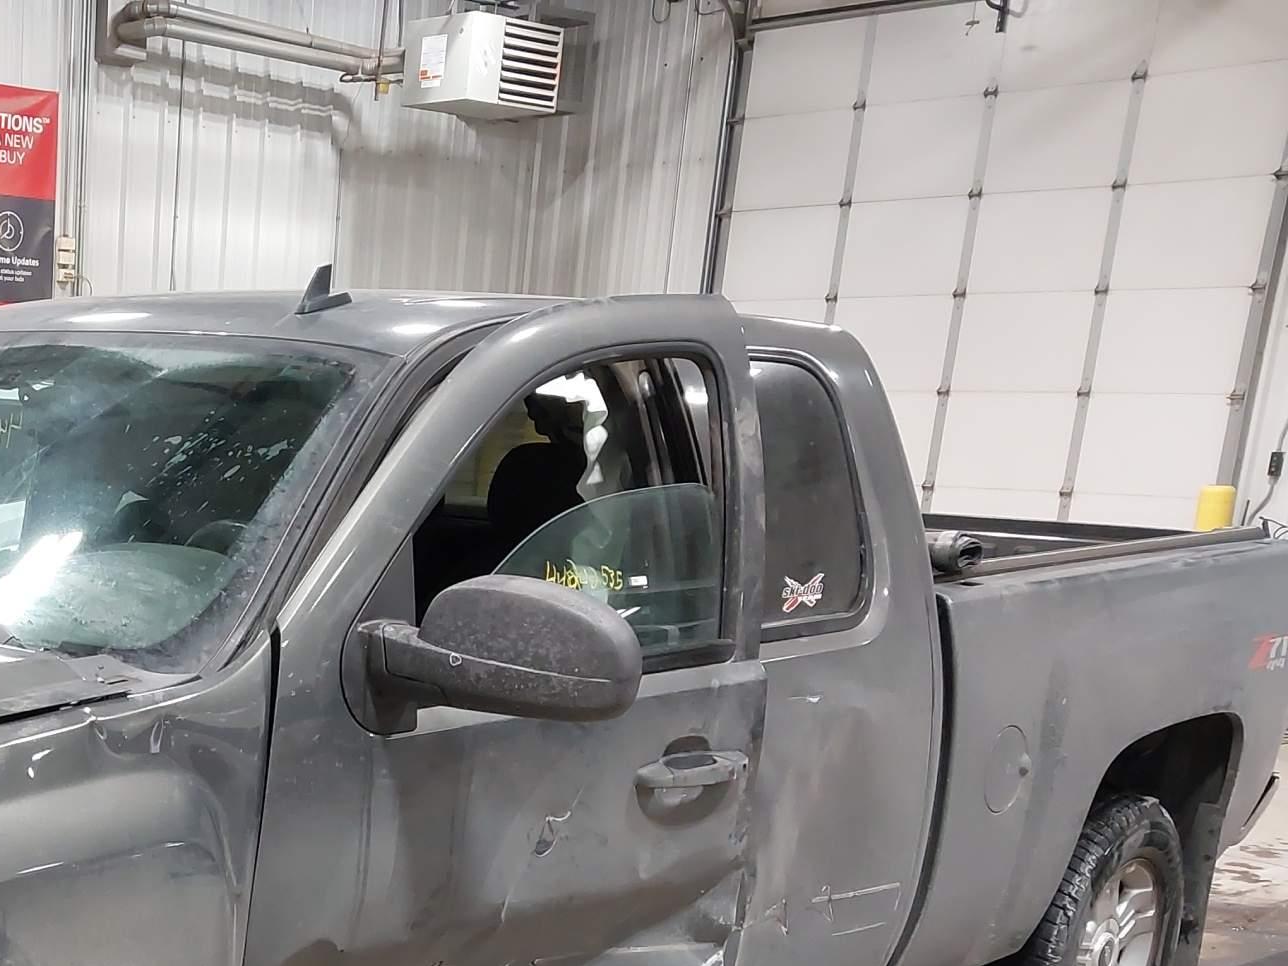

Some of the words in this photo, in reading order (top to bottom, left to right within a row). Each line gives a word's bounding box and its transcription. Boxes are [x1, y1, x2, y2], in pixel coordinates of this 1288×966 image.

[5, 133, 34, 150] NEW
[0, 150, 25, 165] BUY
[12, 256, 40, 267] Updates
